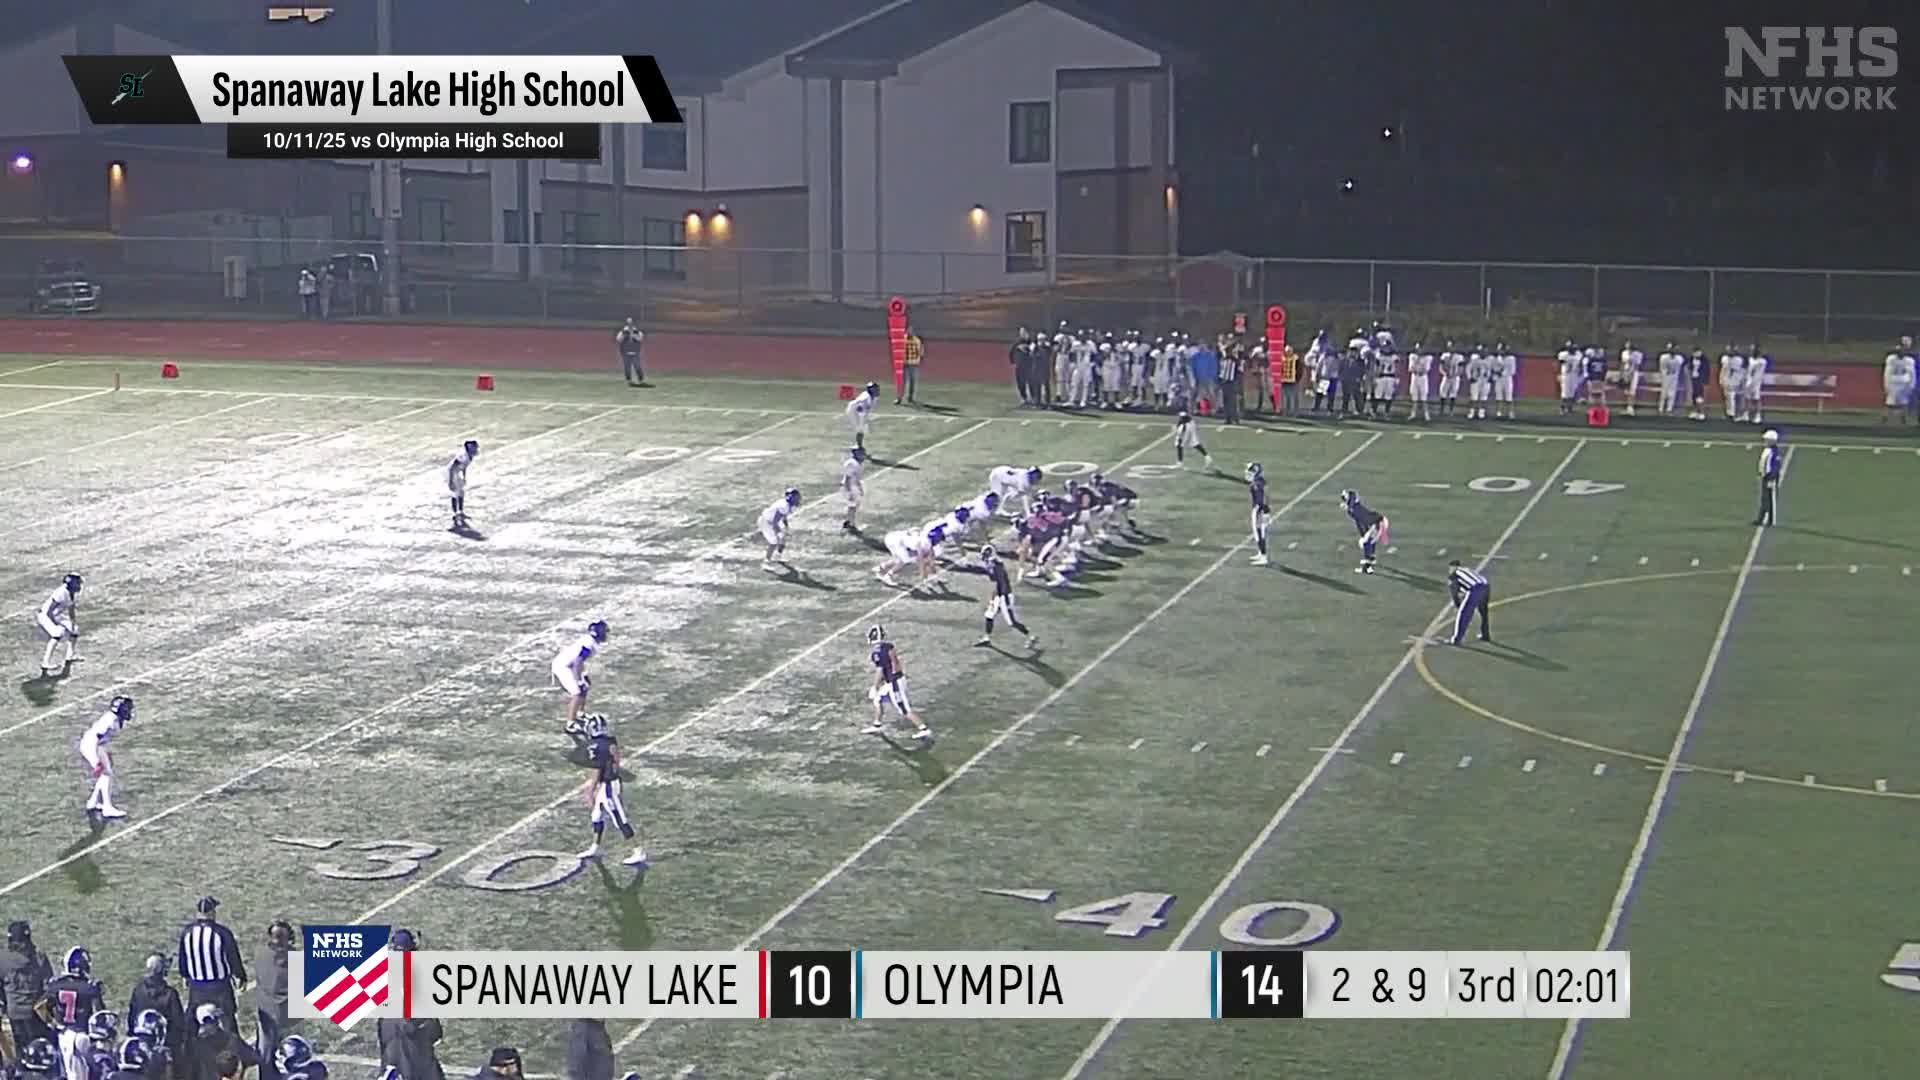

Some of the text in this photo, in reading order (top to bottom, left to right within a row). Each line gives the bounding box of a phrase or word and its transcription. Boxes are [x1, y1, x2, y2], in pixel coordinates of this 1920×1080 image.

[312, 839, 585, 891] 30
[1054, 892, 1342, 947] 40
[58, 990, 78, 1023] 7
